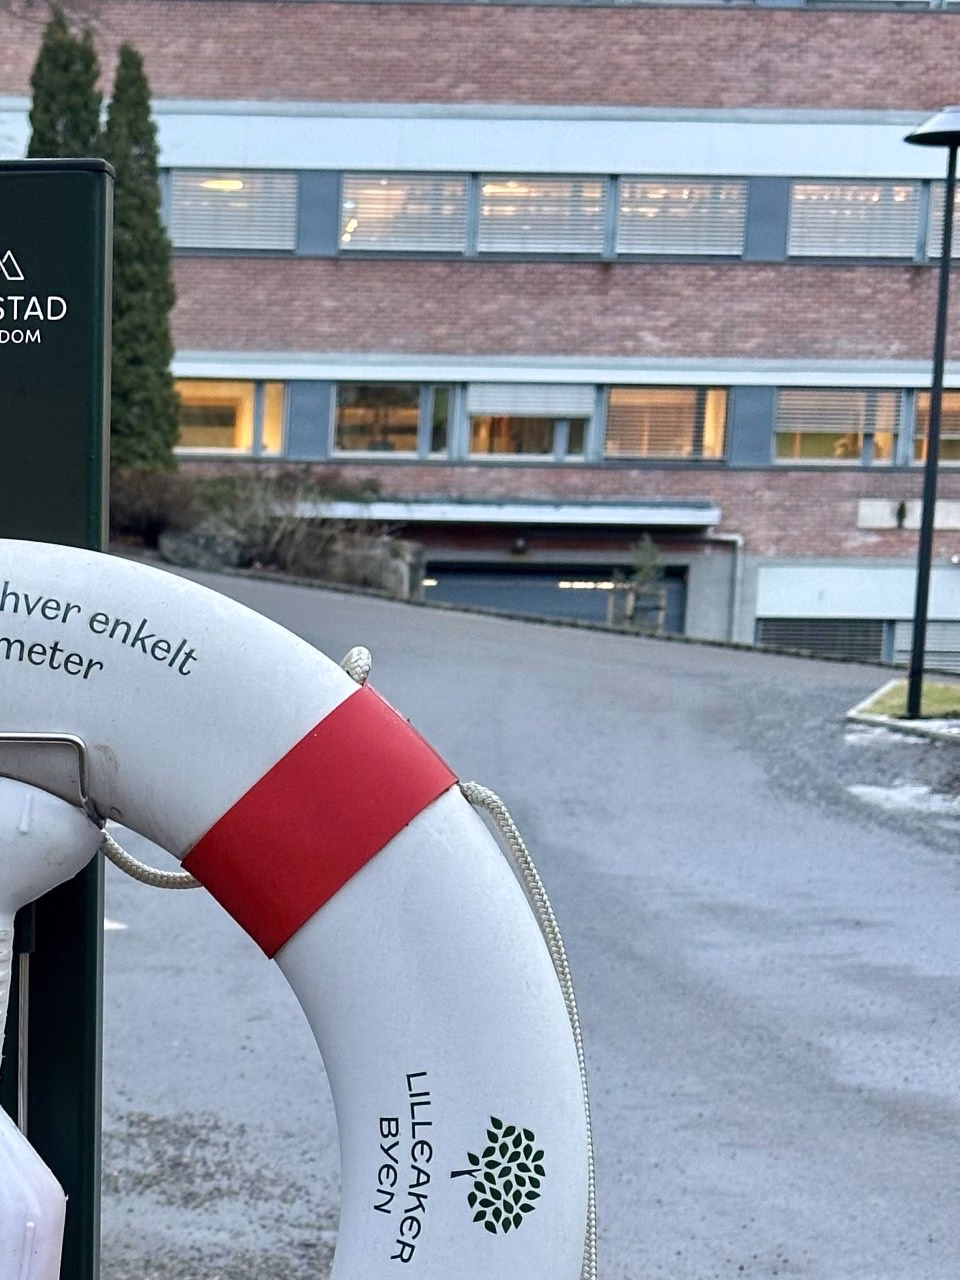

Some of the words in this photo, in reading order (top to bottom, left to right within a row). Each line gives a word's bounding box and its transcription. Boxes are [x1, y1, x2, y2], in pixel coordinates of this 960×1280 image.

[0, 581, 82, 625] hver
[88, 610, 200, 676] enkelt
[373, 1117, 400, 1215] BYEN
[390, 1071, 433, 1264] LILLEAKER
